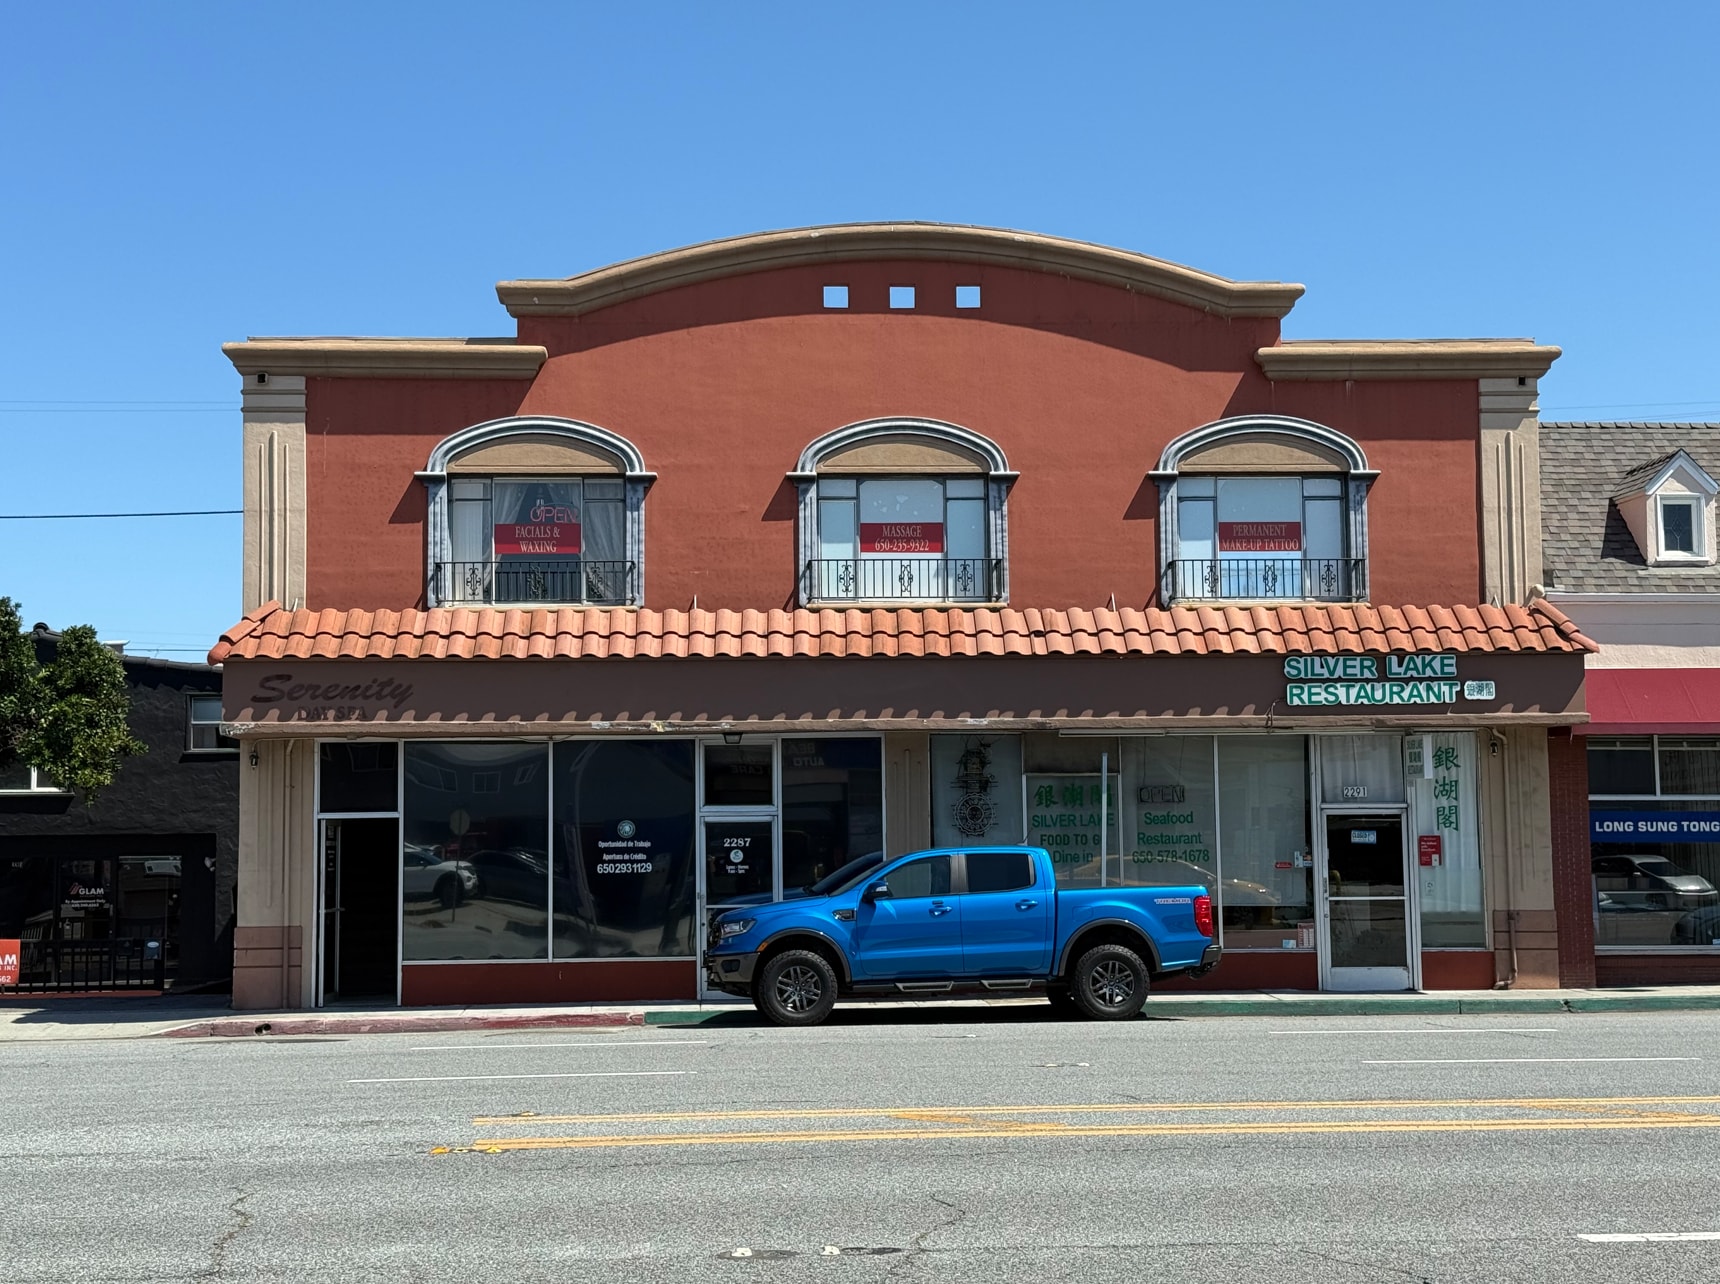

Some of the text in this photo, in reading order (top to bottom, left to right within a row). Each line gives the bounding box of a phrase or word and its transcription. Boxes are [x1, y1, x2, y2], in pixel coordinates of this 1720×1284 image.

[515, 526, 560, 538] FACIALS &
[882, 525, 922, 537] MASSAGE
[1232, 524, 1287, 536] PERMANENT
[519, 541, 557, 553] WAXING
[875, 539, 929, 552] 650-235-9322
[1222, 538, 1299, 550] MAKE-UP TATTOO
[1285, 655, 1456, 678] SILVER LAKE
[250, 673, 414, 709] Serenity
[1288, 681, 1460, 705] RESTAURANT
[297, 706, 368, 721] DAY SPA
[1344, 787, 1366, 797] 2291
[1432, 746, 1461, 831] 銀湖閣
[1032, 814, 1077, 828] SILVER
[1144, 811, 1194, 825] Seafood
[1595, 821, 1720, 832] LONG SUNG TONG
[723, 837, 751, 847] 2287
[1040, 834, 1070, 846] FOOD
[1073, 833, 1088, 846] TO
[1137, 832, 1203, 846] Restaurant
[1053, 849, 1094, 863] Dine in
[1132, 849, 1210, 863] 650-578-1678
